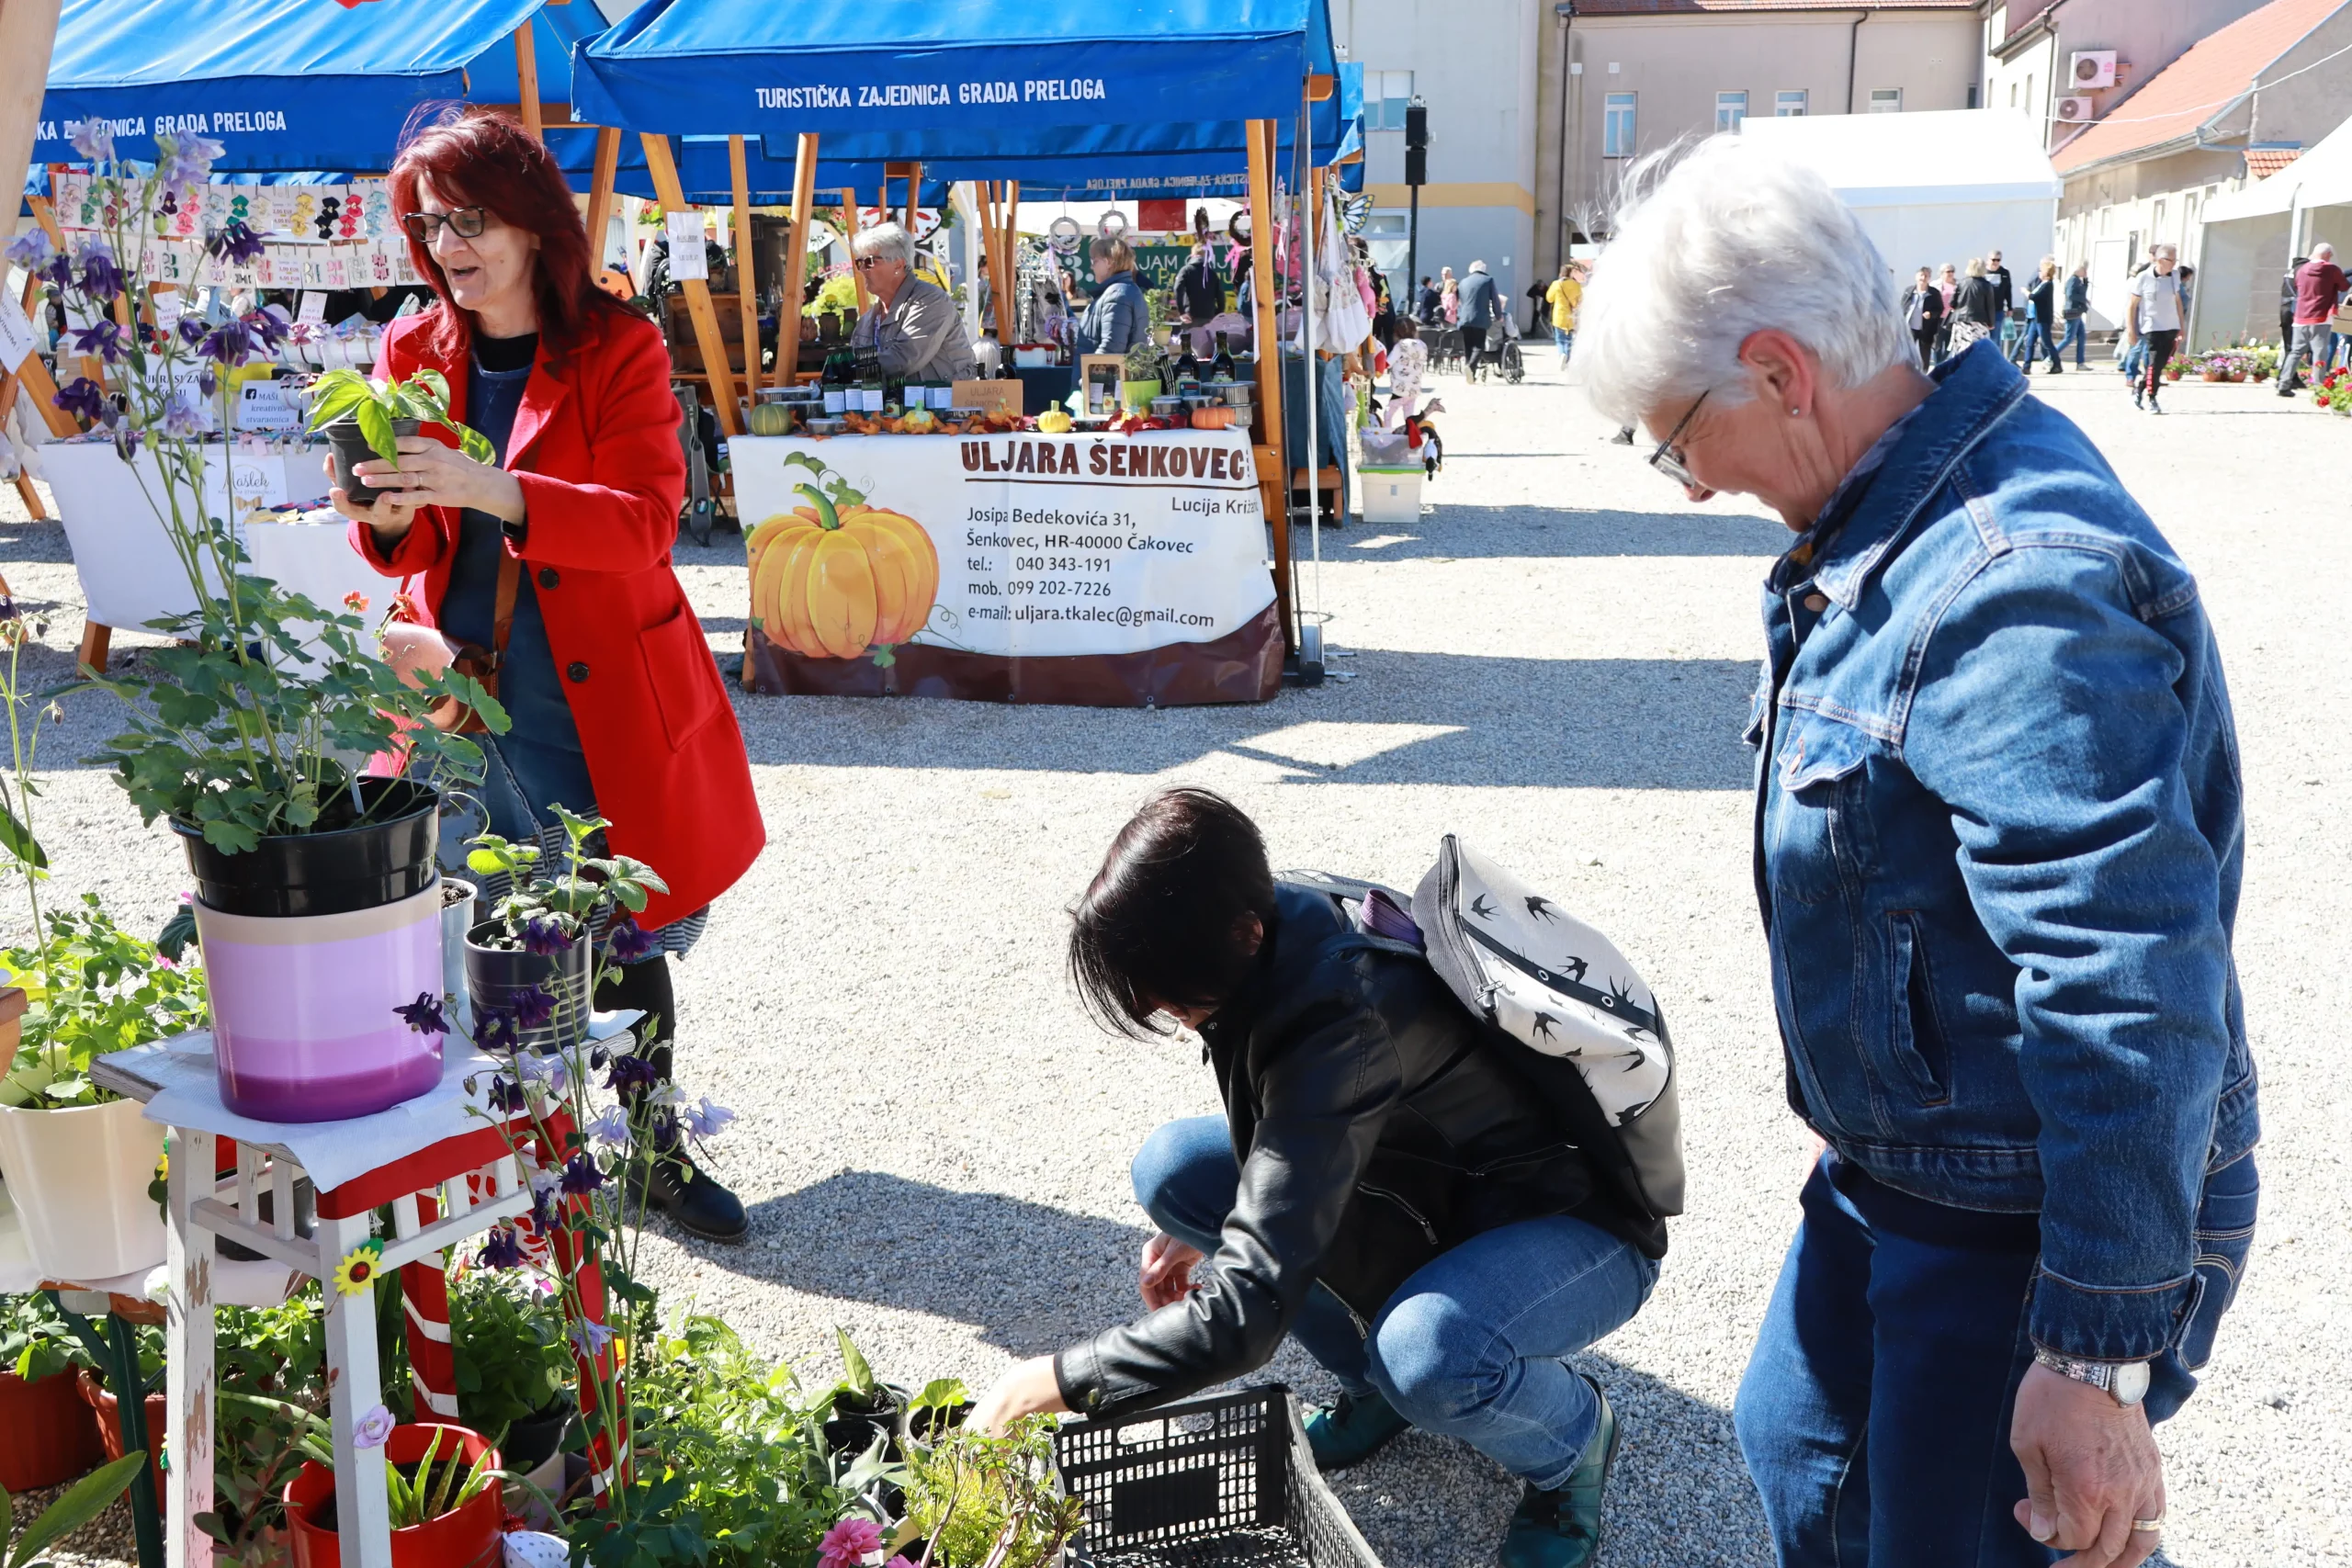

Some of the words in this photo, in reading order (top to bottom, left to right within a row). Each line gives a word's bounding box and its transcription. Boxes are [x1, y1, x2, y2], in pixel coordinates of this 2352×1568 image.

[754, 84, 852, 109] TURISTIČKA
[857, 84, 951, 107] ZAJEDNICA
[958, 81, 1019, 105] GRADA
[1024, 78, 1106, 102] PRELOGA
[154, 112, 209, 135] GRADA
[213, 110, 287, 132] PRELOGA
[187, 375, 199, 384] ZA
[970, 386, 1005, 397] ULJARA
[961, 440, 1080, 476] ULJARA
[1089, 437, 1246, 481] ŠENKOVEC
[1171, 496, 1220, 517] Lucija
[967, 507, 1009, 527] Josipa
[1012, 508, 1108, 527] Bedekovića
[1113, 513, 1136, 529] 31,
[967, 528, 1039, 551] Šenkovec,
[1045, 534, 1123, 550] HR-40000
[1126, 533, 1194, 554] Čakovec
[967, 557, 993, 571] tel.:
[1016, 557, 1045, 571] 040
[1048, 557, 1111, 572] 343-191
[968, 581, 1002, 596] mob.
[1007, 581, 1035, 596] 099
[1038, 581, 1112, 597] 202-7226
[967, 605, 1012, 622] e-mail:
[1014, 604, 1215, 627] uljara.tkalec@gmail.com
